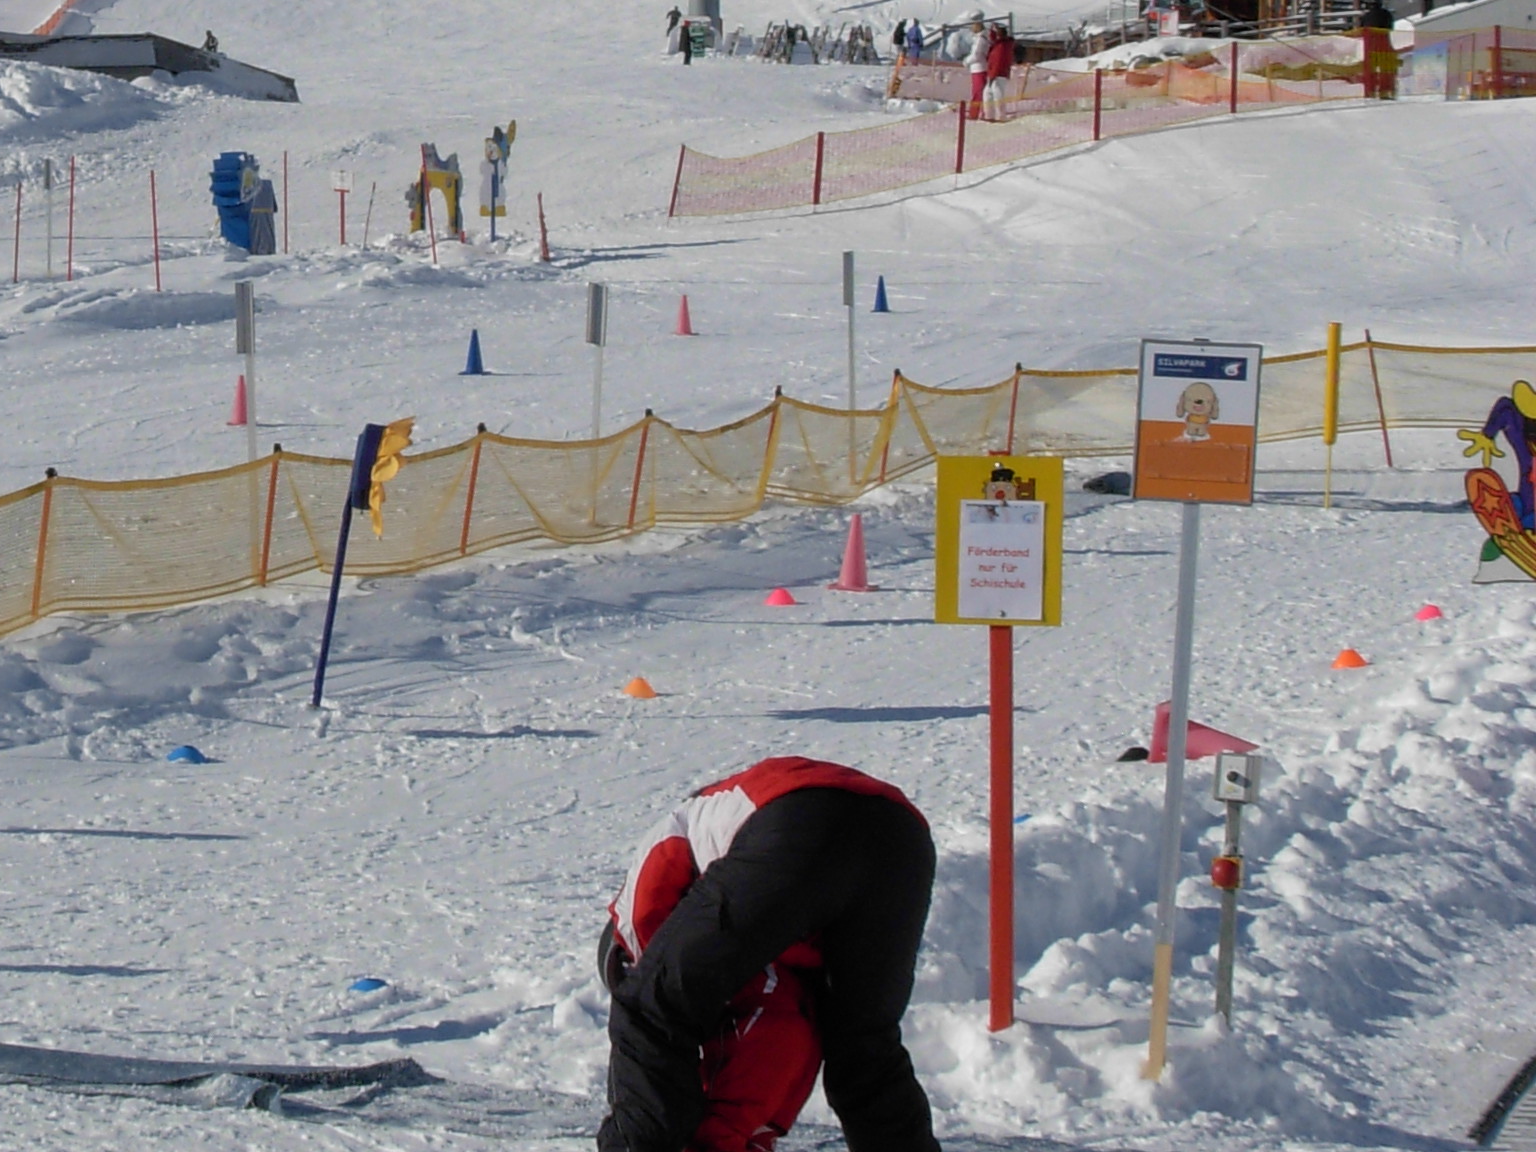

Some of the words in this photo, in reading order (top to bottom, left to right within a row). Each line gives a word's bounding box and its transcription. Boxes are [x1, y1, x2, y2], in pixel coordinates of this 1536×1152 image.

[967, 546, 1030, 558] Förderband
[978, 564, 996, 573] nur
[1001, 563, 1018, 573] für
[970, 578, 1026, 589] Schischule
